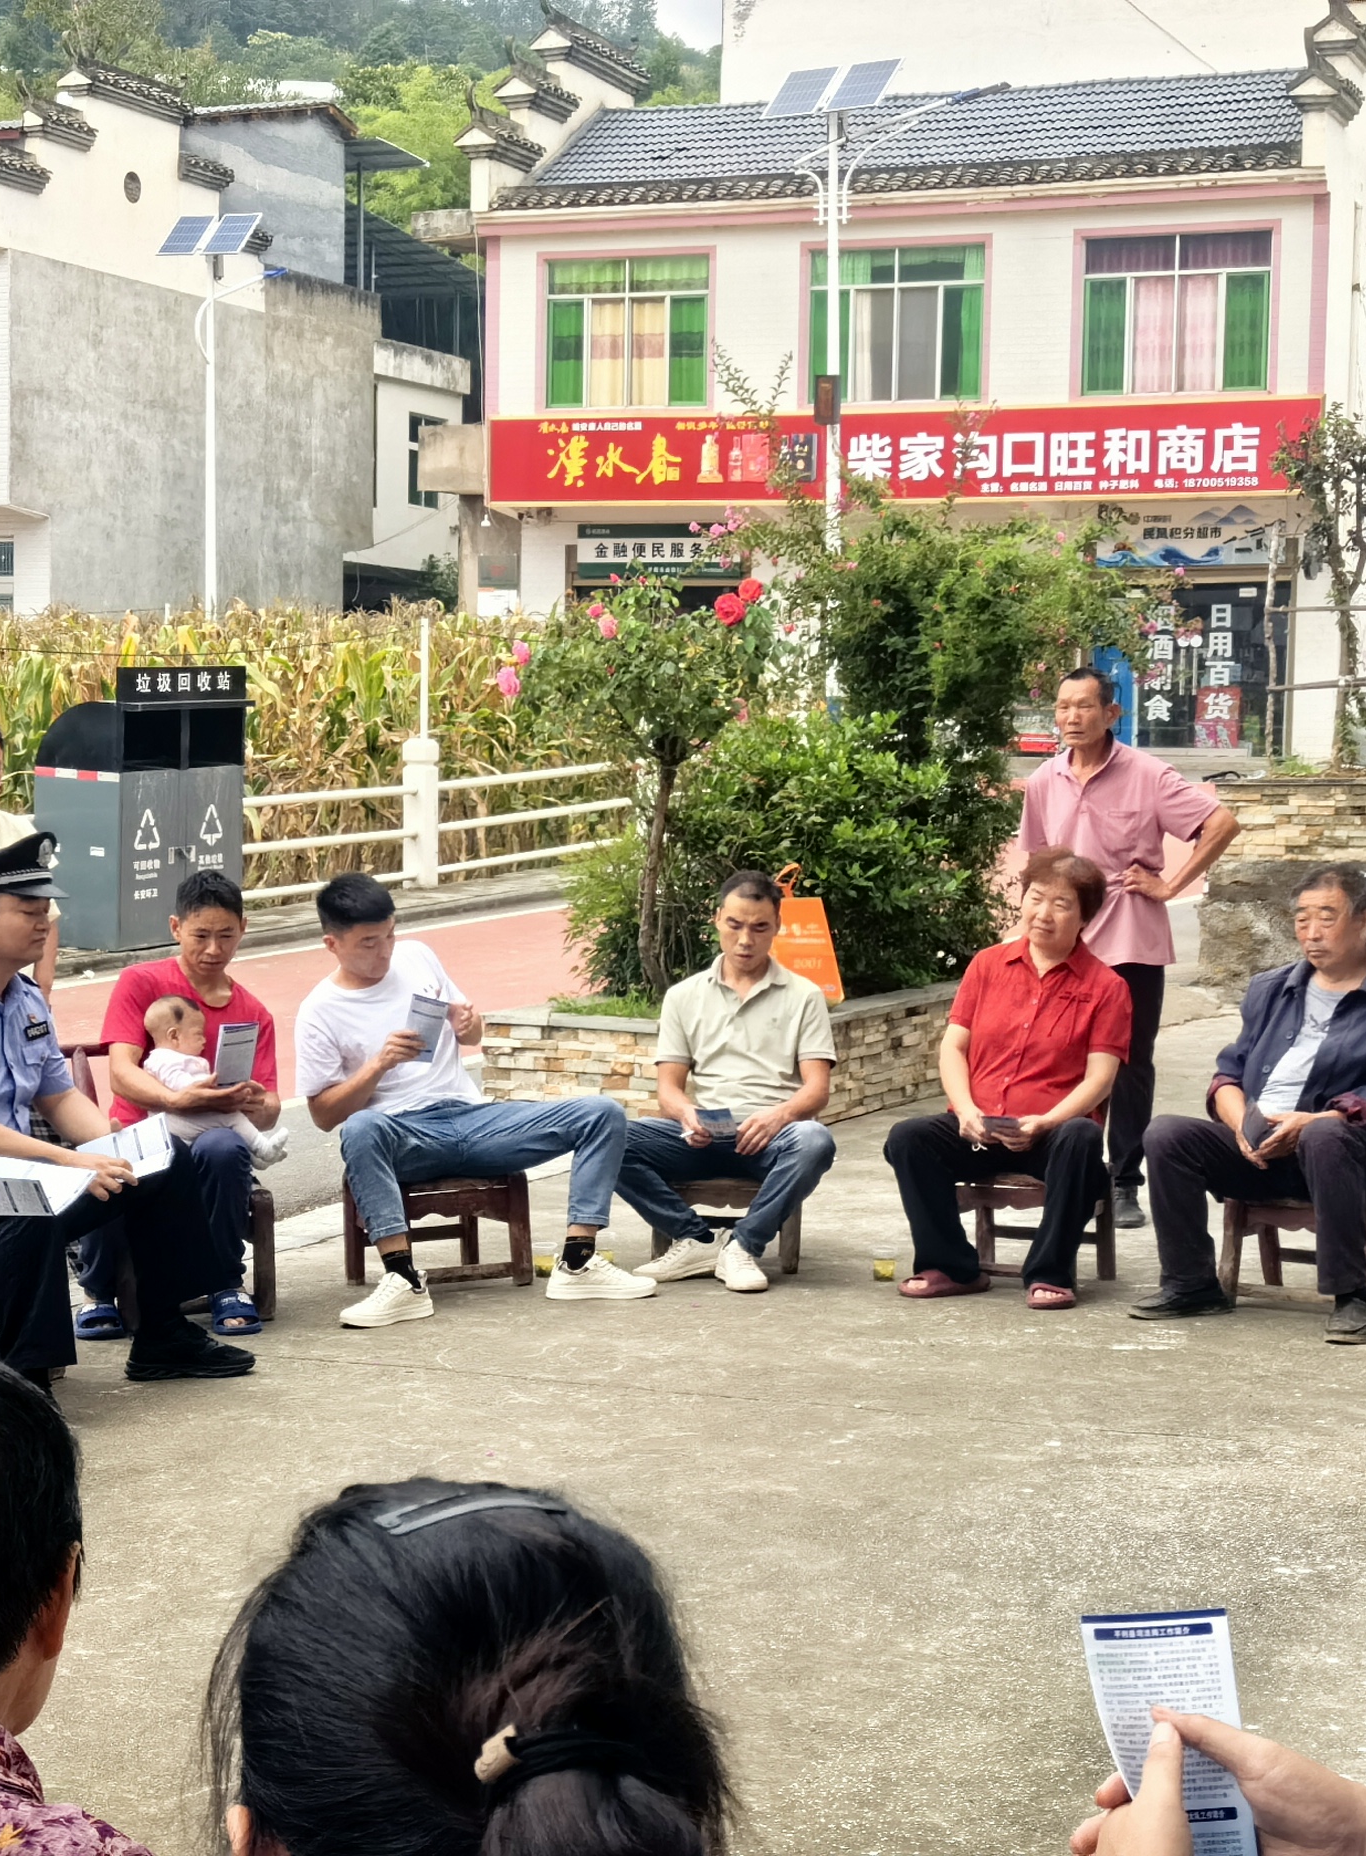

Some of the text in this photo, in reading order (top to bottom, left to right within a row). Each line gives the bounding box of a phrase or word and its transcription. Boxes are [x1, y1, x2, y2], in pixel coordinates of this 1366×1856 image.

[847, 422, 1261, 482] 柴家沟口旺和商店
[135, 671, 231, 693] 垃圾回收站
[1204, 603, 1235, 720] 日用百货
